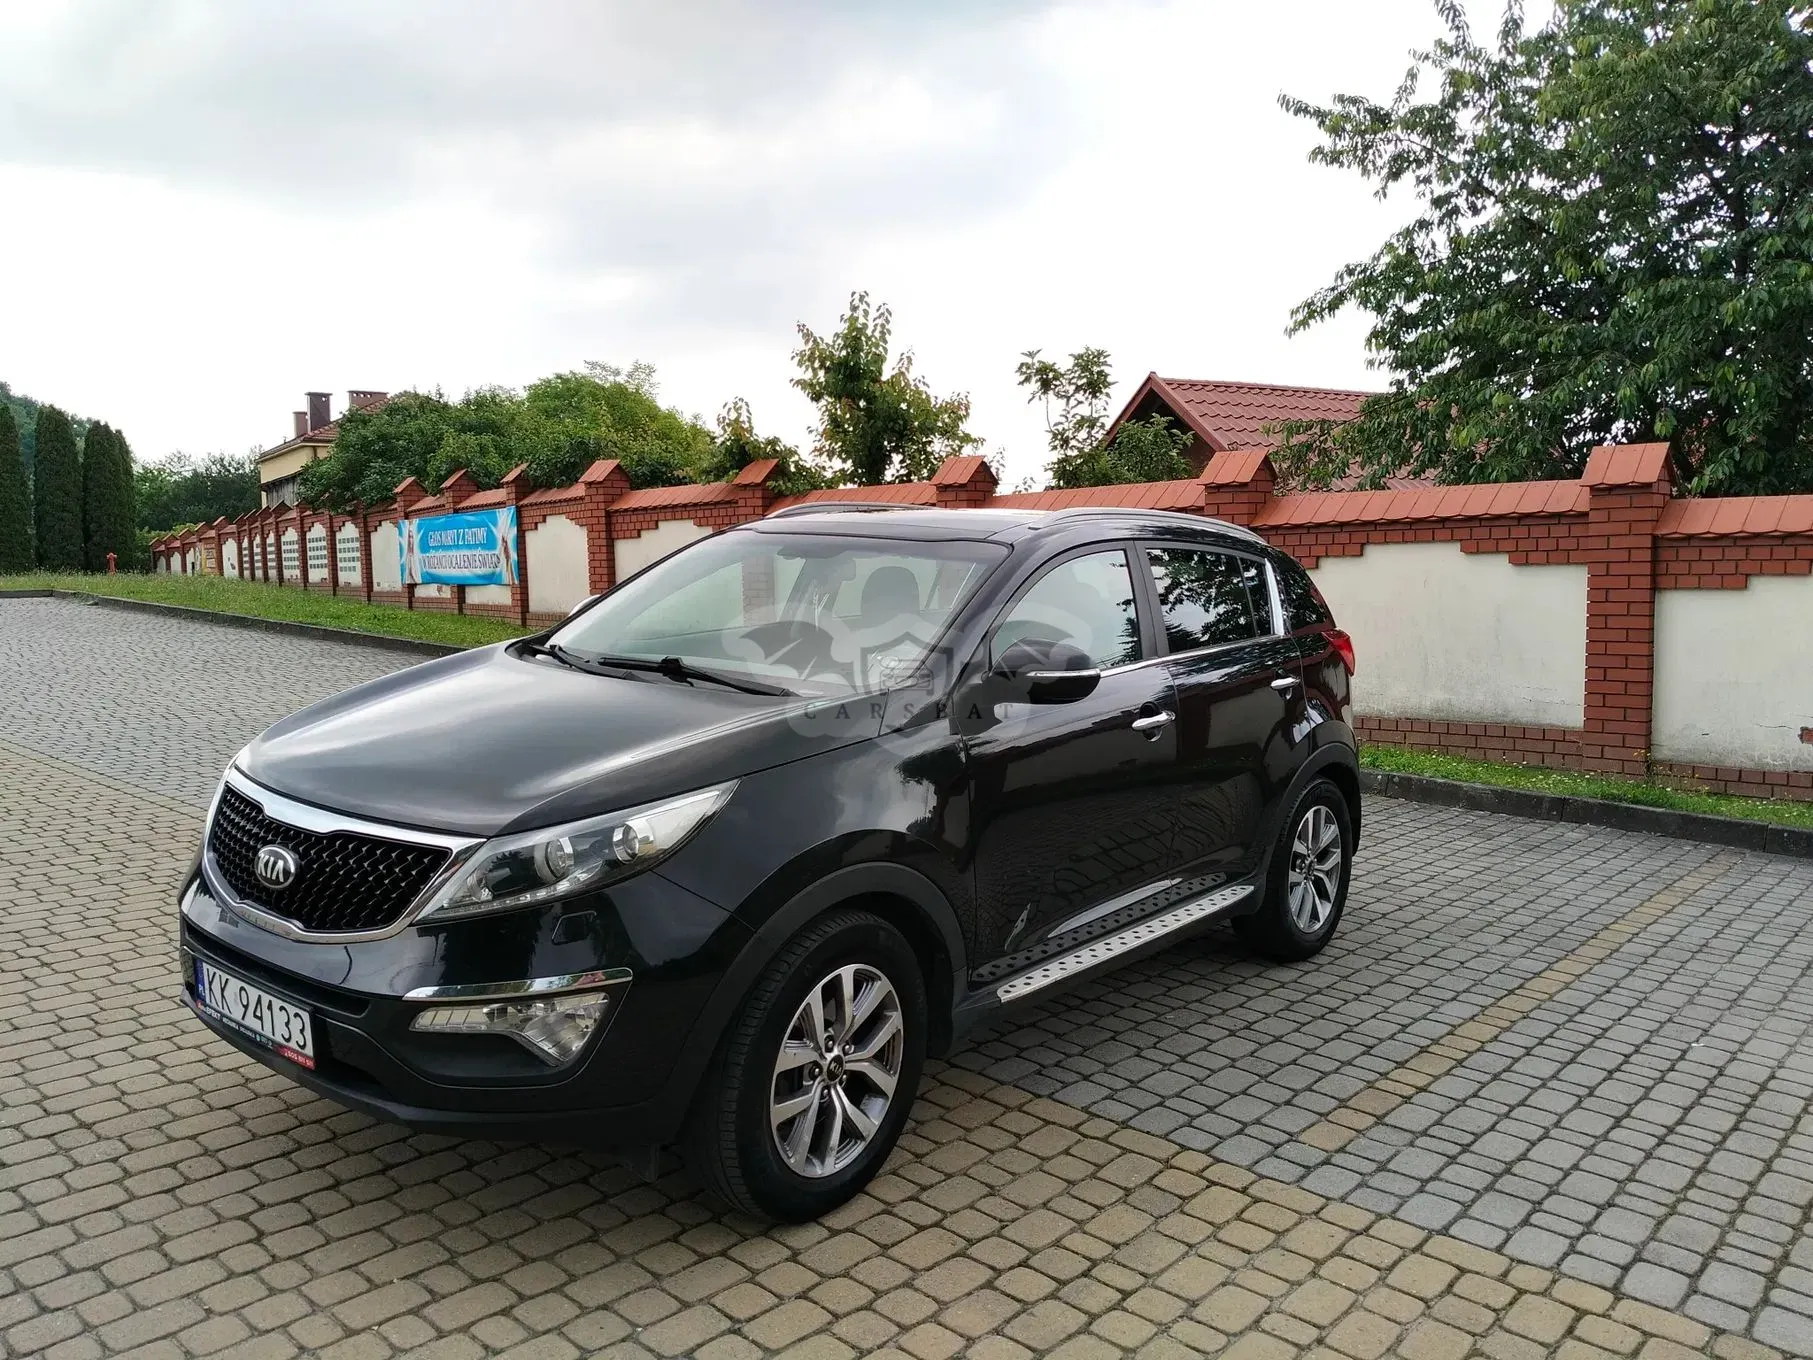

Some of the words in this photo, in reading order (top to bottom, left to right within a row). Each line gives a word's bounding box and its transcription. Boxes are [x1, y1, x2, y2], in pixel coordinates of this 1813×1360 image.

[458, 529, 464, 545] Z
[465, 527, 488, 545] FATIMY
[448, 553, 478, 570] OCALENIE
[257, 853, 284, 883] KIA
[198, 984, 206, 997] PL
[206, 967, 232, 1015] KK
[238, 985, 306, 1051] 94133
[829, 1061, 842, 1076] KIA
